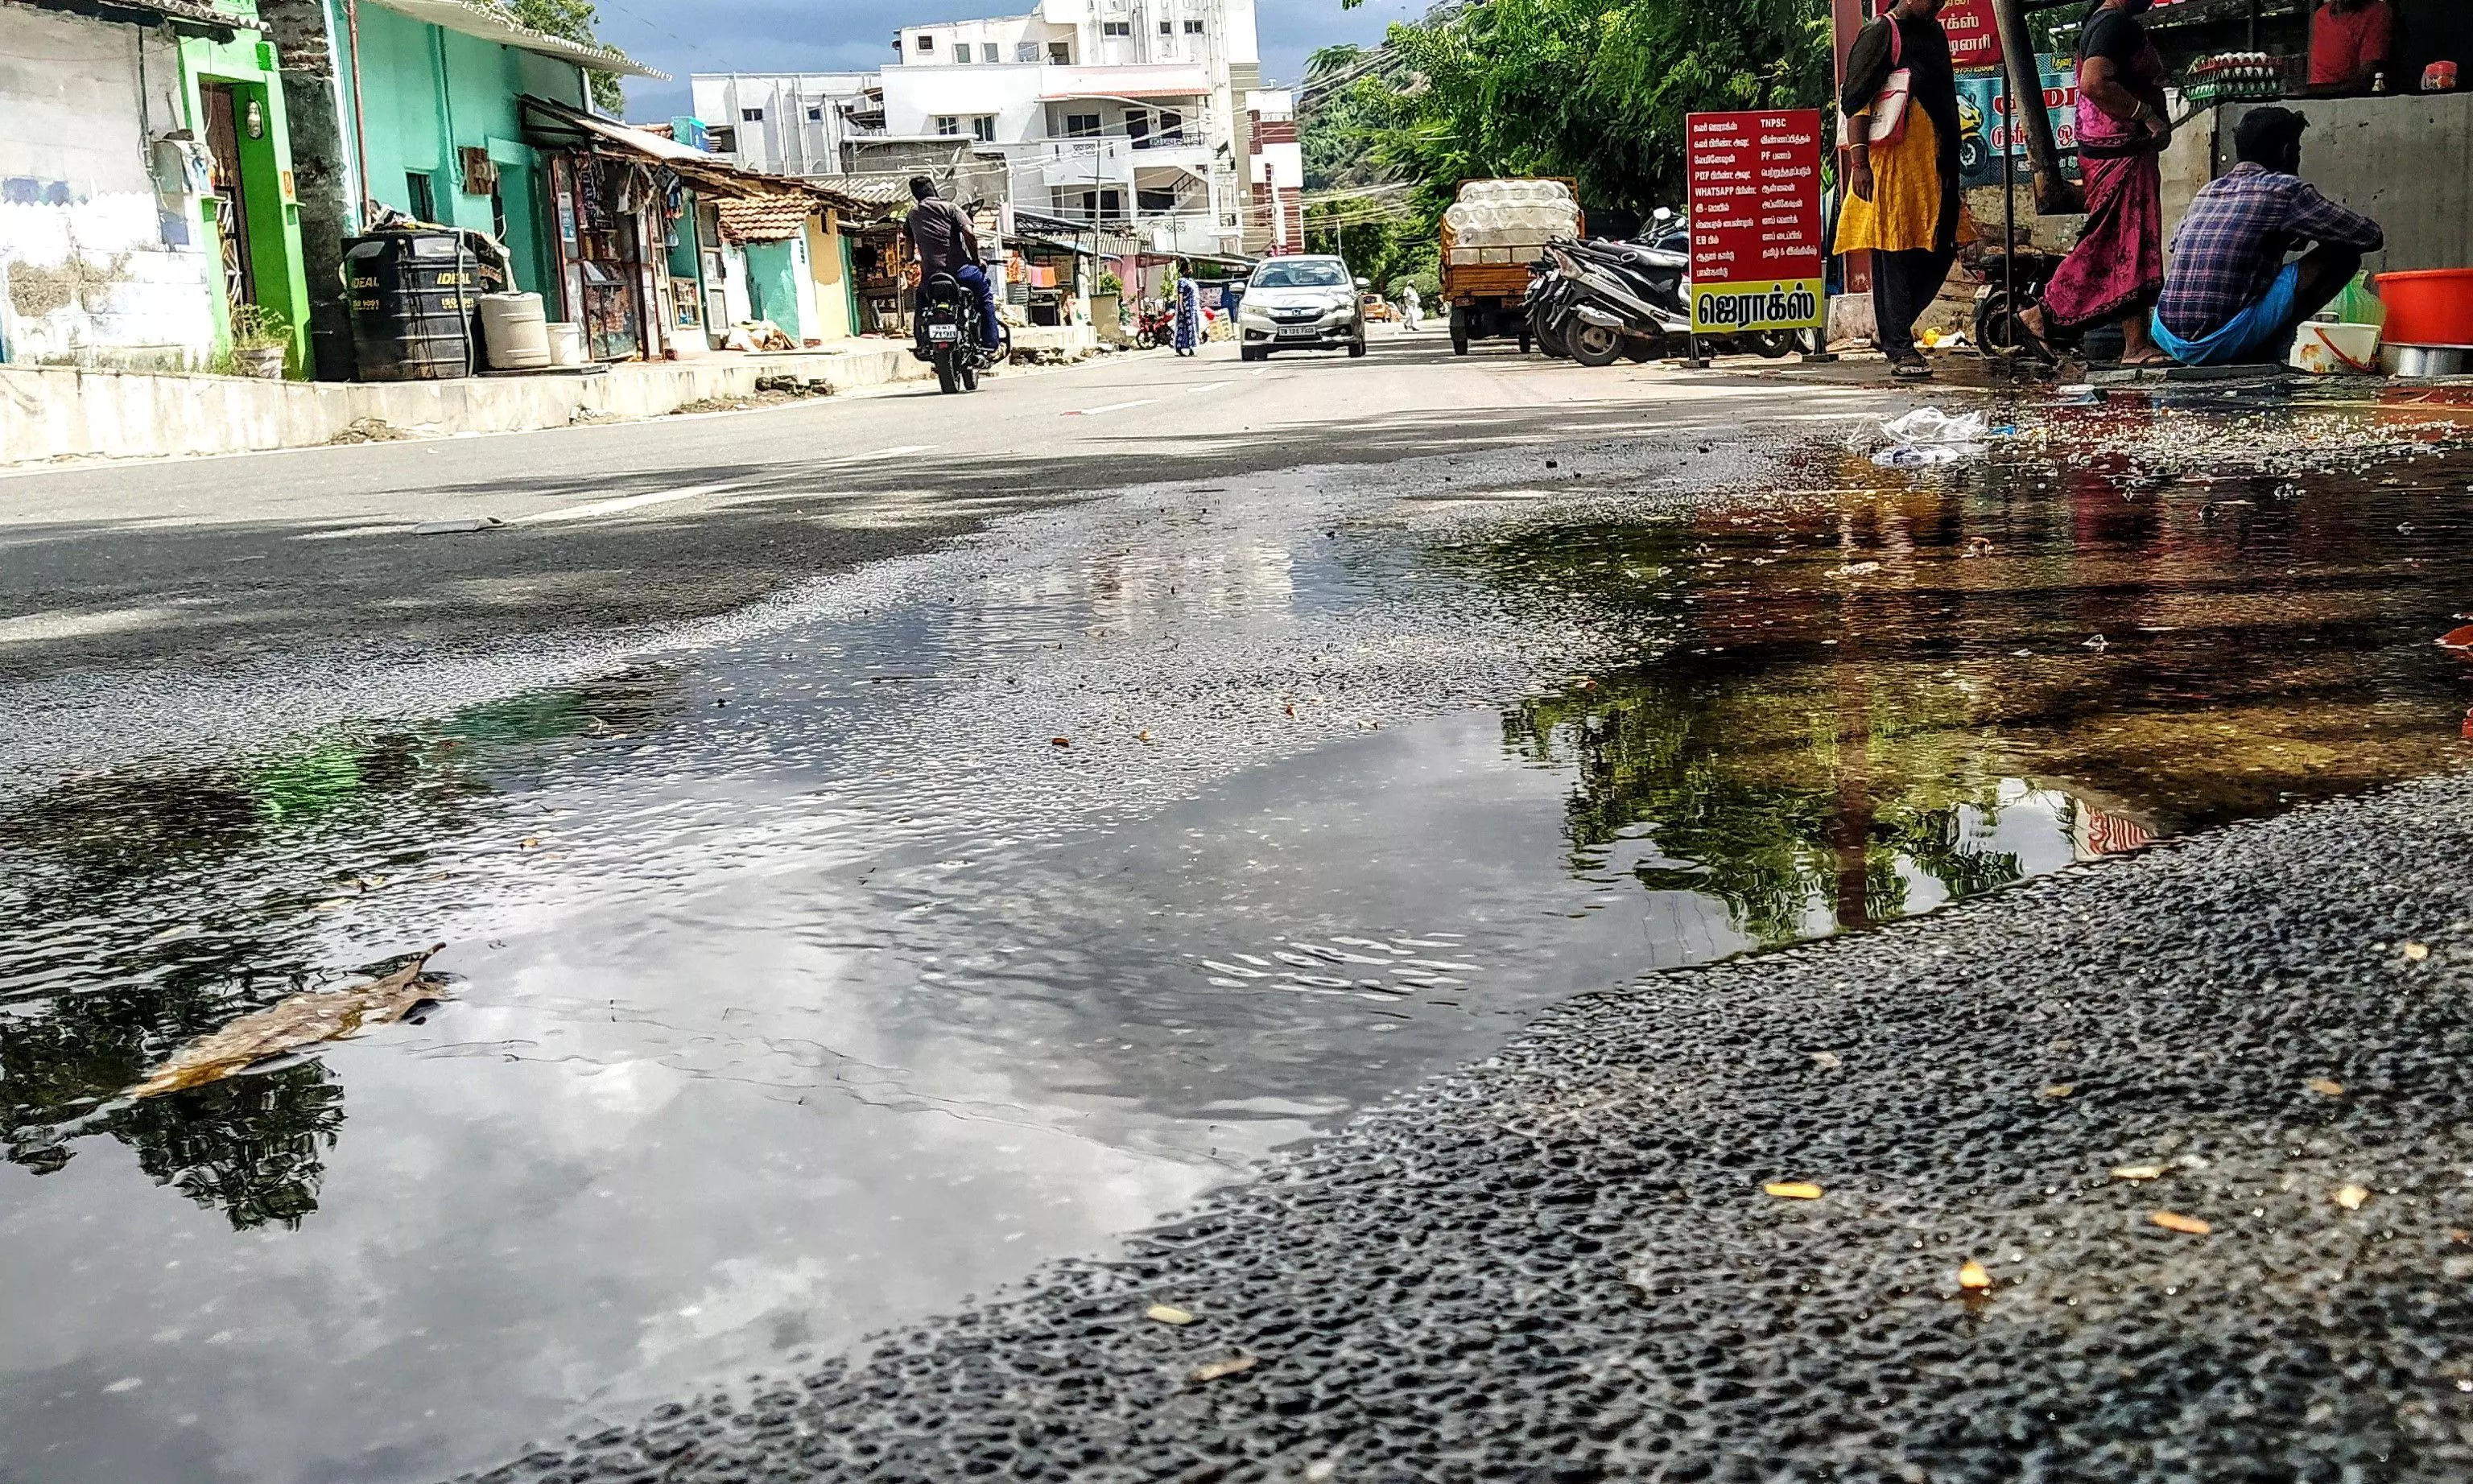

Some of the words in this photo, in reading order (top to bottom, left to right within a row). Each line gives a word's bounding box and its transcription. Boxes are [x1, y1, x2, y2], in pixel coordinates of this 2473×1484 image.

[1760, 118, 1786, 128] TNPSC
[1761, 151, 1771, 160] PF
[1695, 187, 1734, 197] WHATSAPP
[1695, 236, 1707, 245] EB
[350, 277, 380, 289] IDEAL
[1698, 281, 1816, 328] ஜெராக்ஸ்
